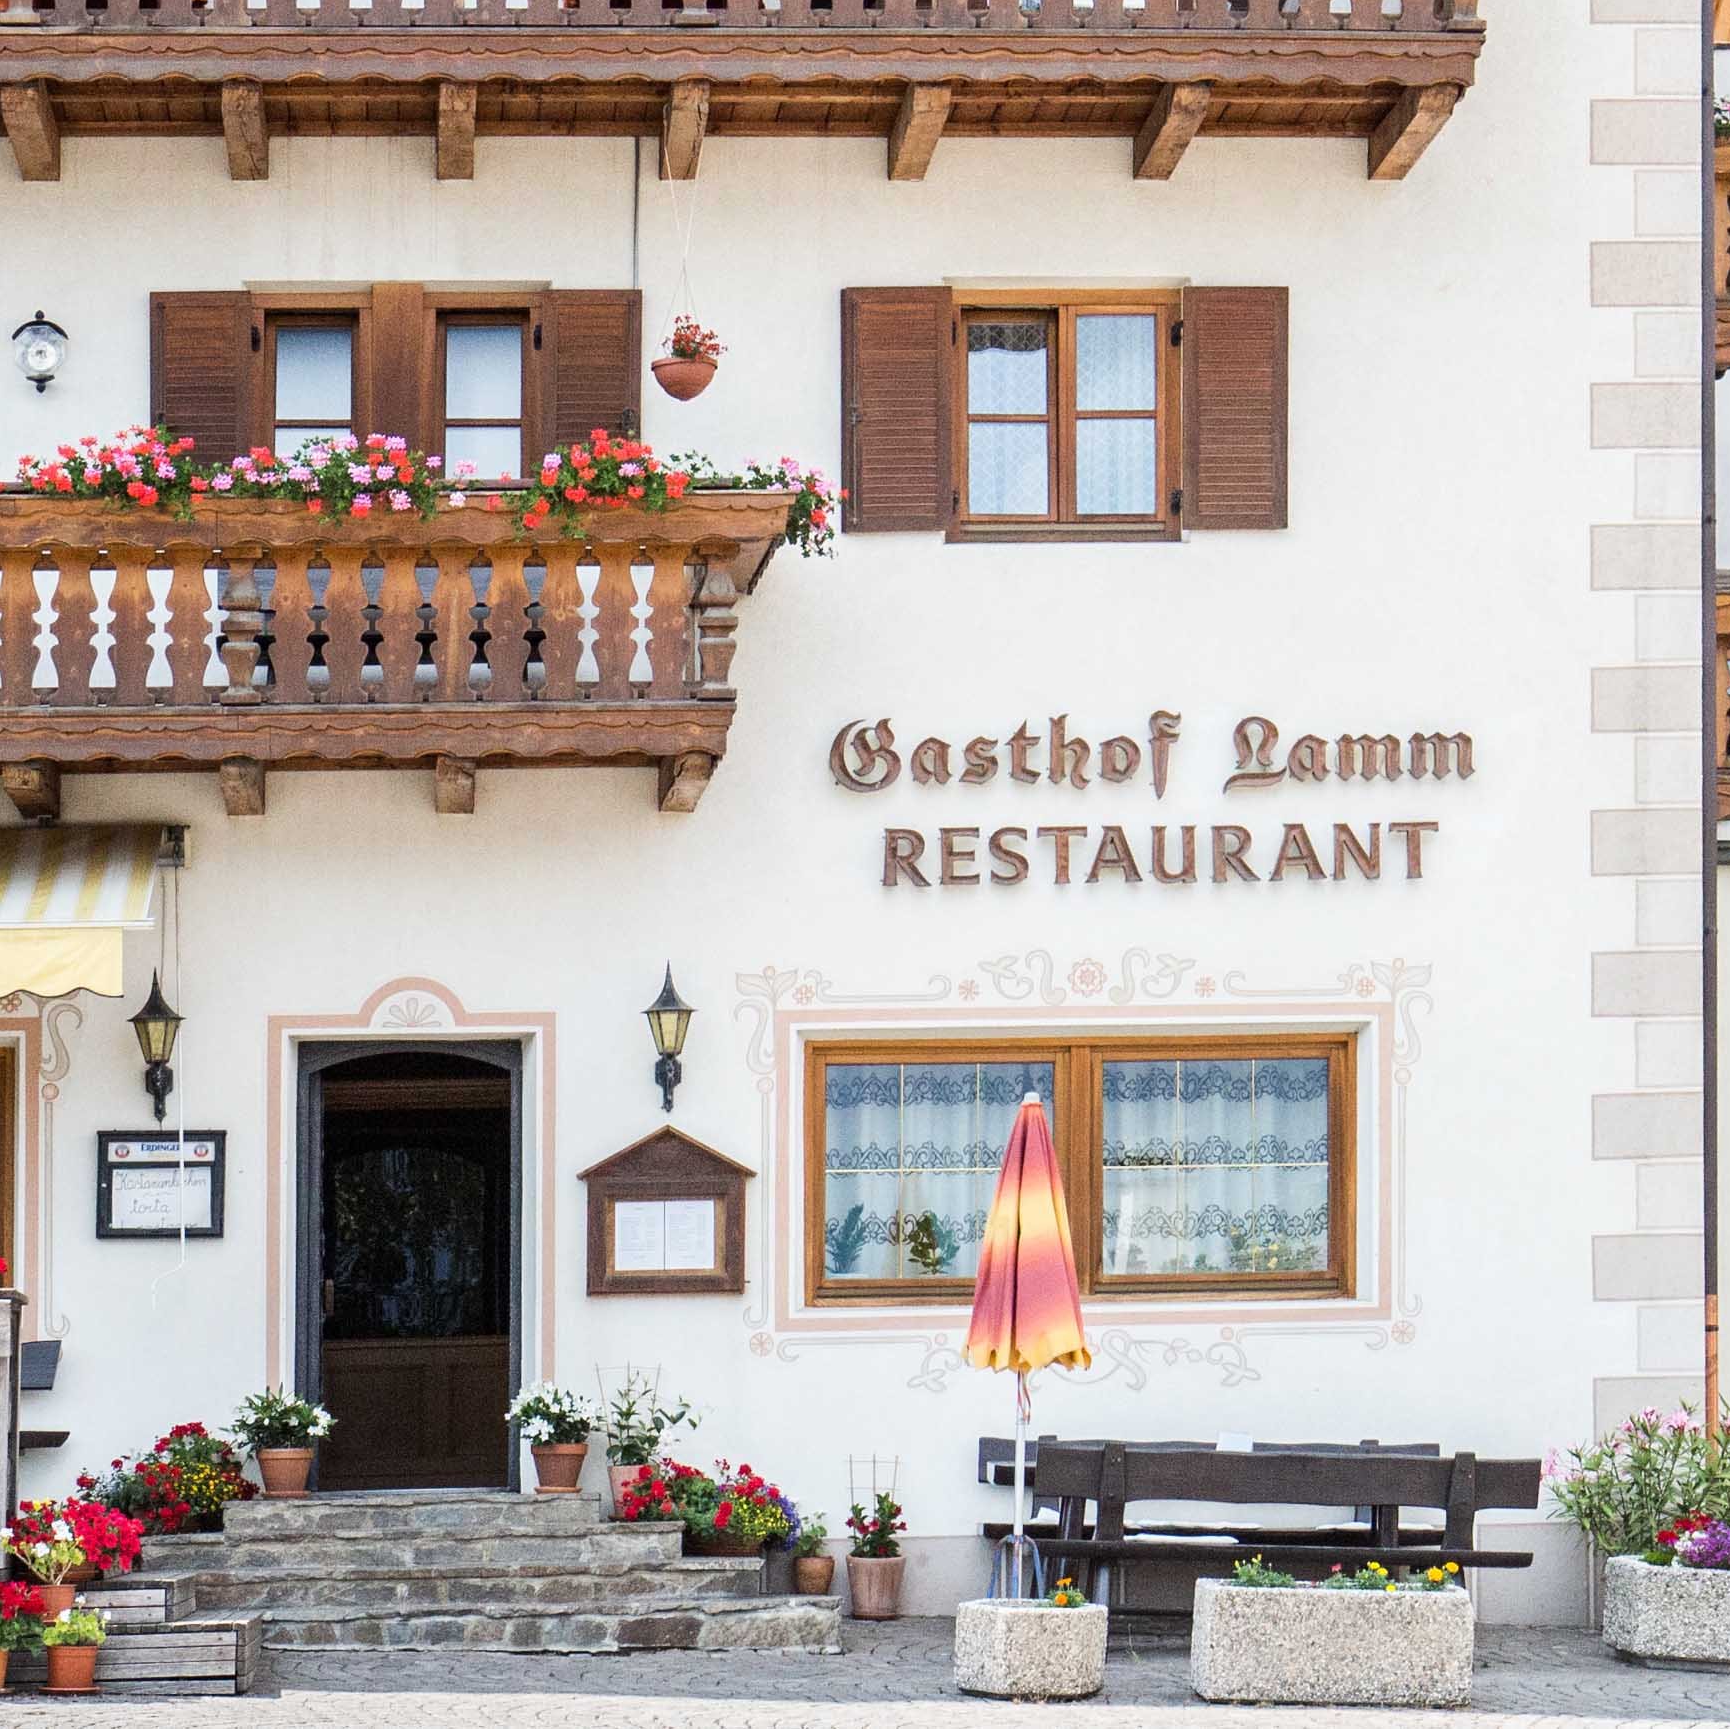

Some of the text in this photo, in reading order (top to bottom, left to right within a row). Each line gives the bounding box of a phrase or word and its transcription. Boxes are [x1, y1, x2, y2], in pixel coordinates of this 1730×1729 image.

[828, 710, 1476, 800] Gasthof Lamm
[880, 821, 1439, 888] RESTAURANT
